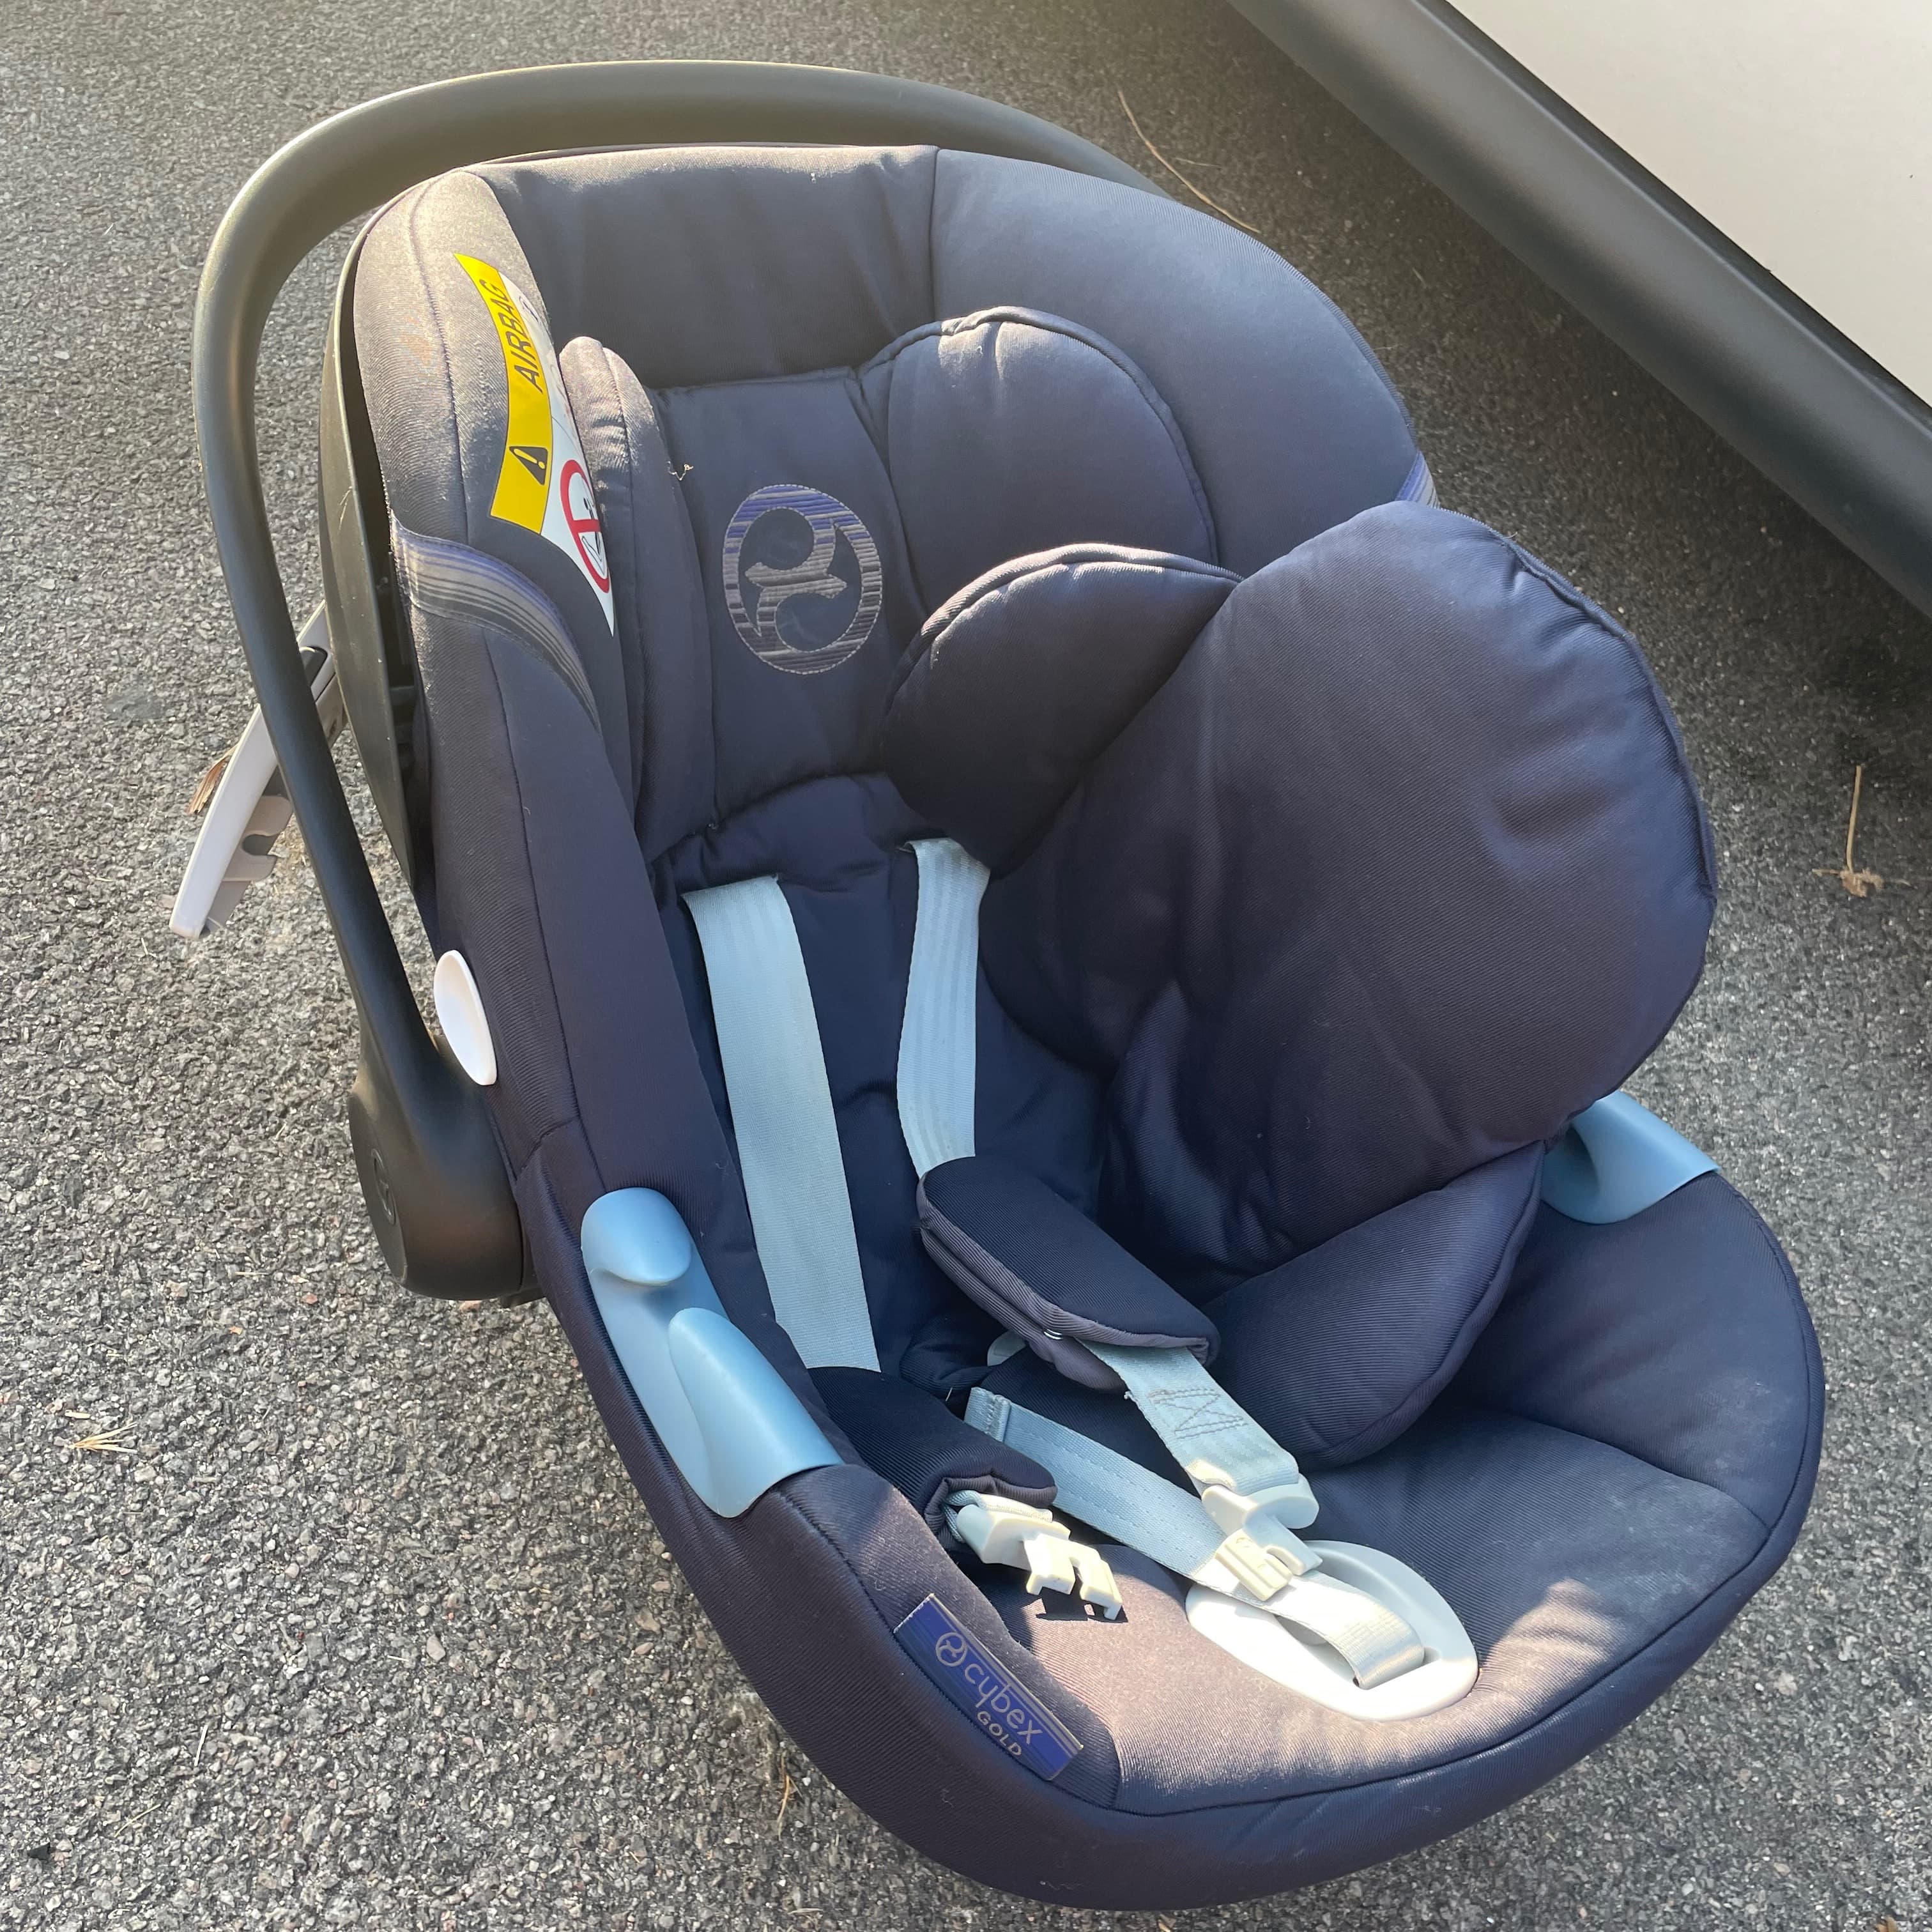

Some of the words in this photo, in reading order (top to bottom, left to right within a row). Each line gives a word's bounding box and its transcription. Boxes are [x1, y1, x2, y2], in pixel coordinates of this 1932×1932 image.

[480, 279, 542, 393] AIRBAG
[965, 1664, 1043, 1744] cybex
[977, 1711, 1022, 1756] GOLD
